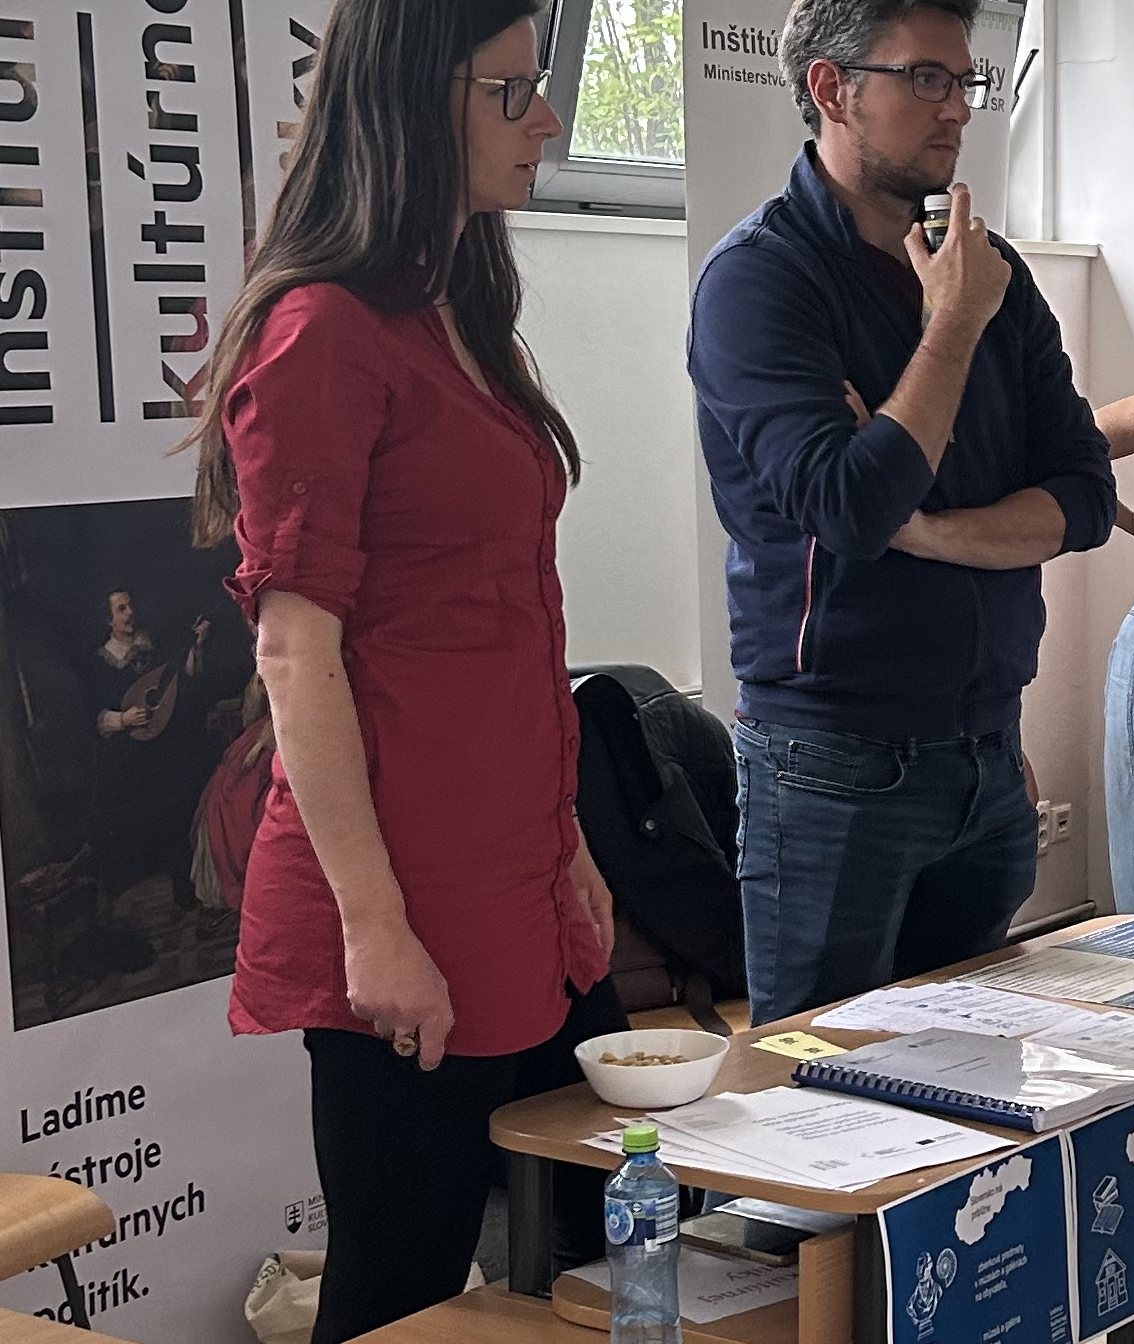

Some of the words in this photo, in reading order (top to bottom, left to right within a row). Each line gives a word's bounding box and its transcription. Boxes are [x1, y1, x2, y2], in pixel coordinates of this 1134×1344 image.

[702, 21, 779, 57] Inštitú
[703, 63, 787, 87] Ministerstvo
[20, 1083, 146, 1144] Ladíme
[48, 1137, 162, 1188] stroje
